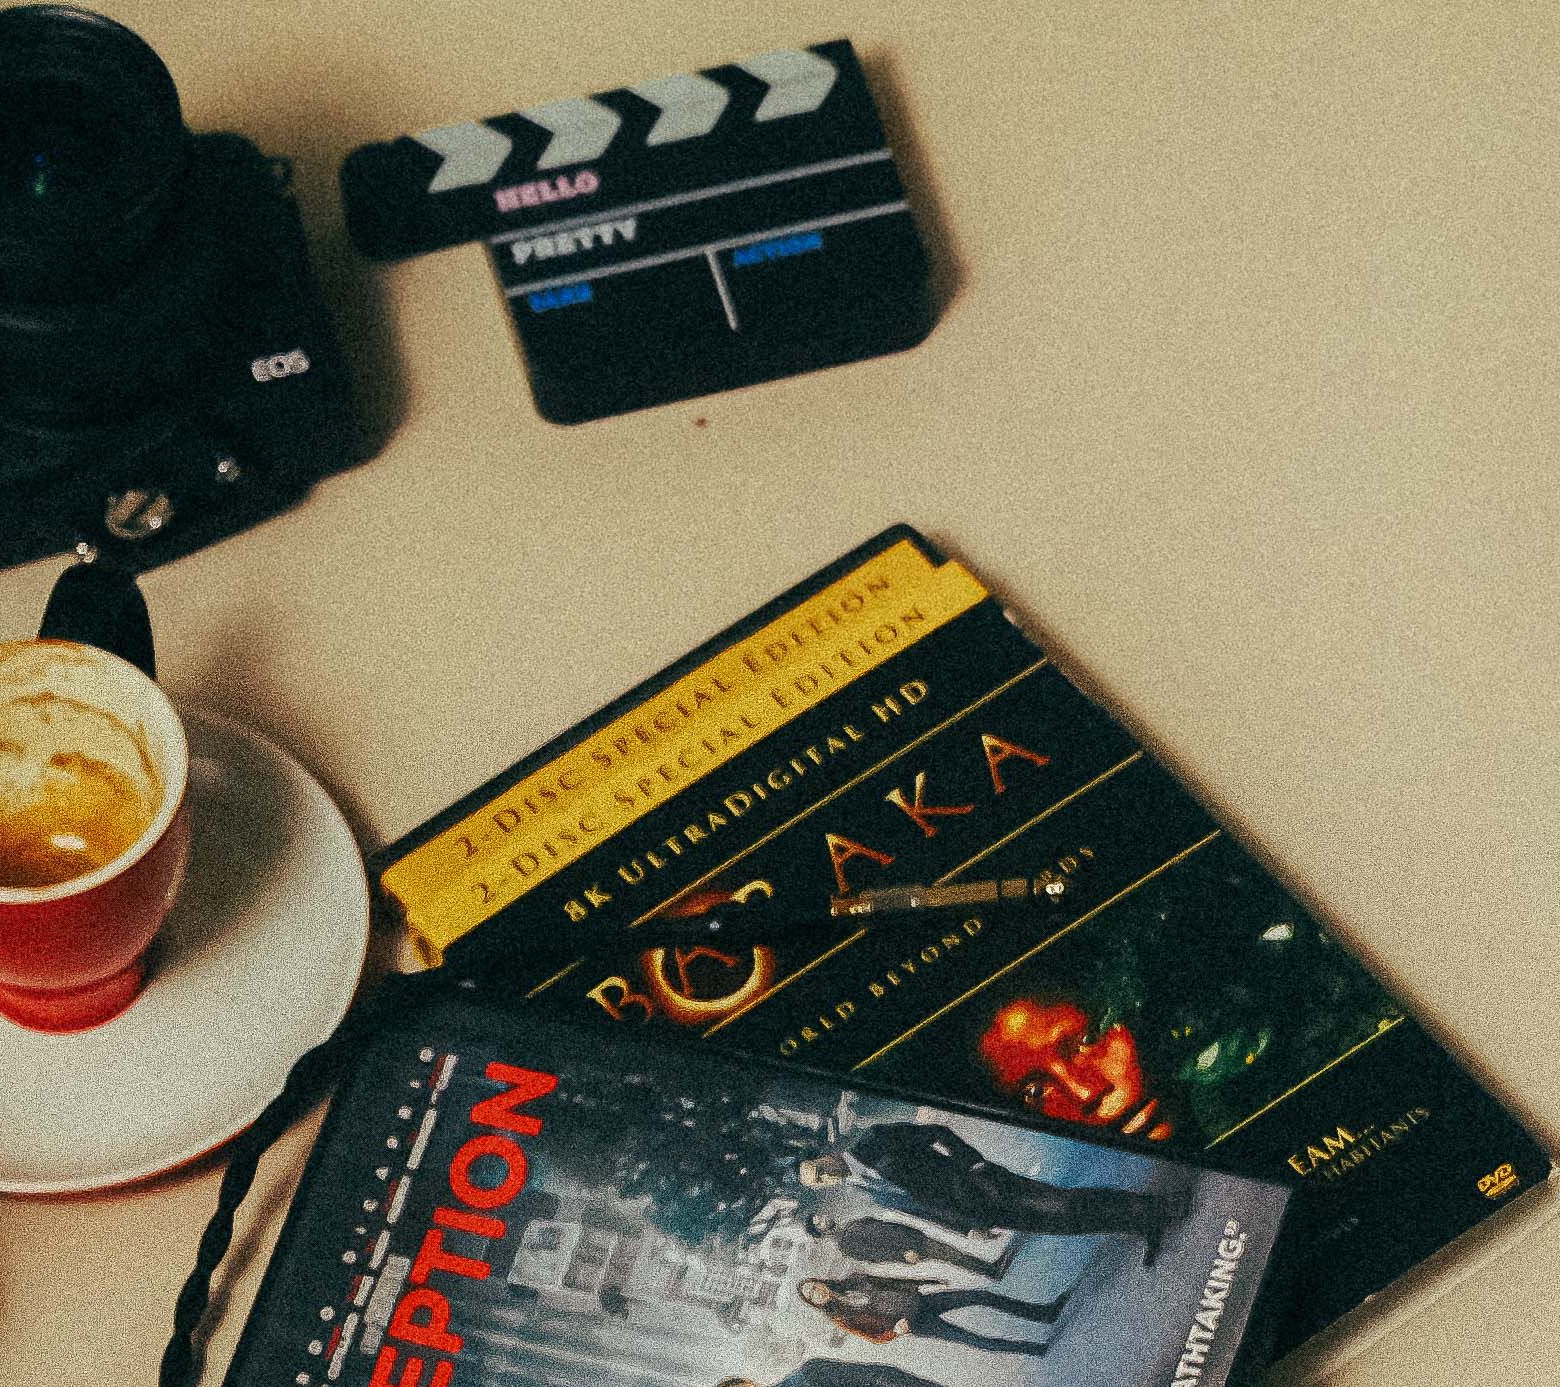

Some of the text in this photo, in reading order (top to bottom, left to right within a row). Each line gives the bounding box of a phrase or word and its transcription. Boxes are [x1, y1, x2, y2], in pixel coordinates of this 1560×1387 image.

[250, 348, 310, 382] EOS
[590, 675, 733, 768] SPECIAL
[742, 576, 890, 676] EDITION
[613, 713, 761, 809] SPECIAL
[770, 607, 925, 711] EDITION
[563, 883, 612, 922] 8K
[870, 678, 929, 723] HD
[779, 1001, 857, 1056] ORLD
[868, 917, 984, 998] BEYOND
[1475, 1161, 1517, 1197] DVD
